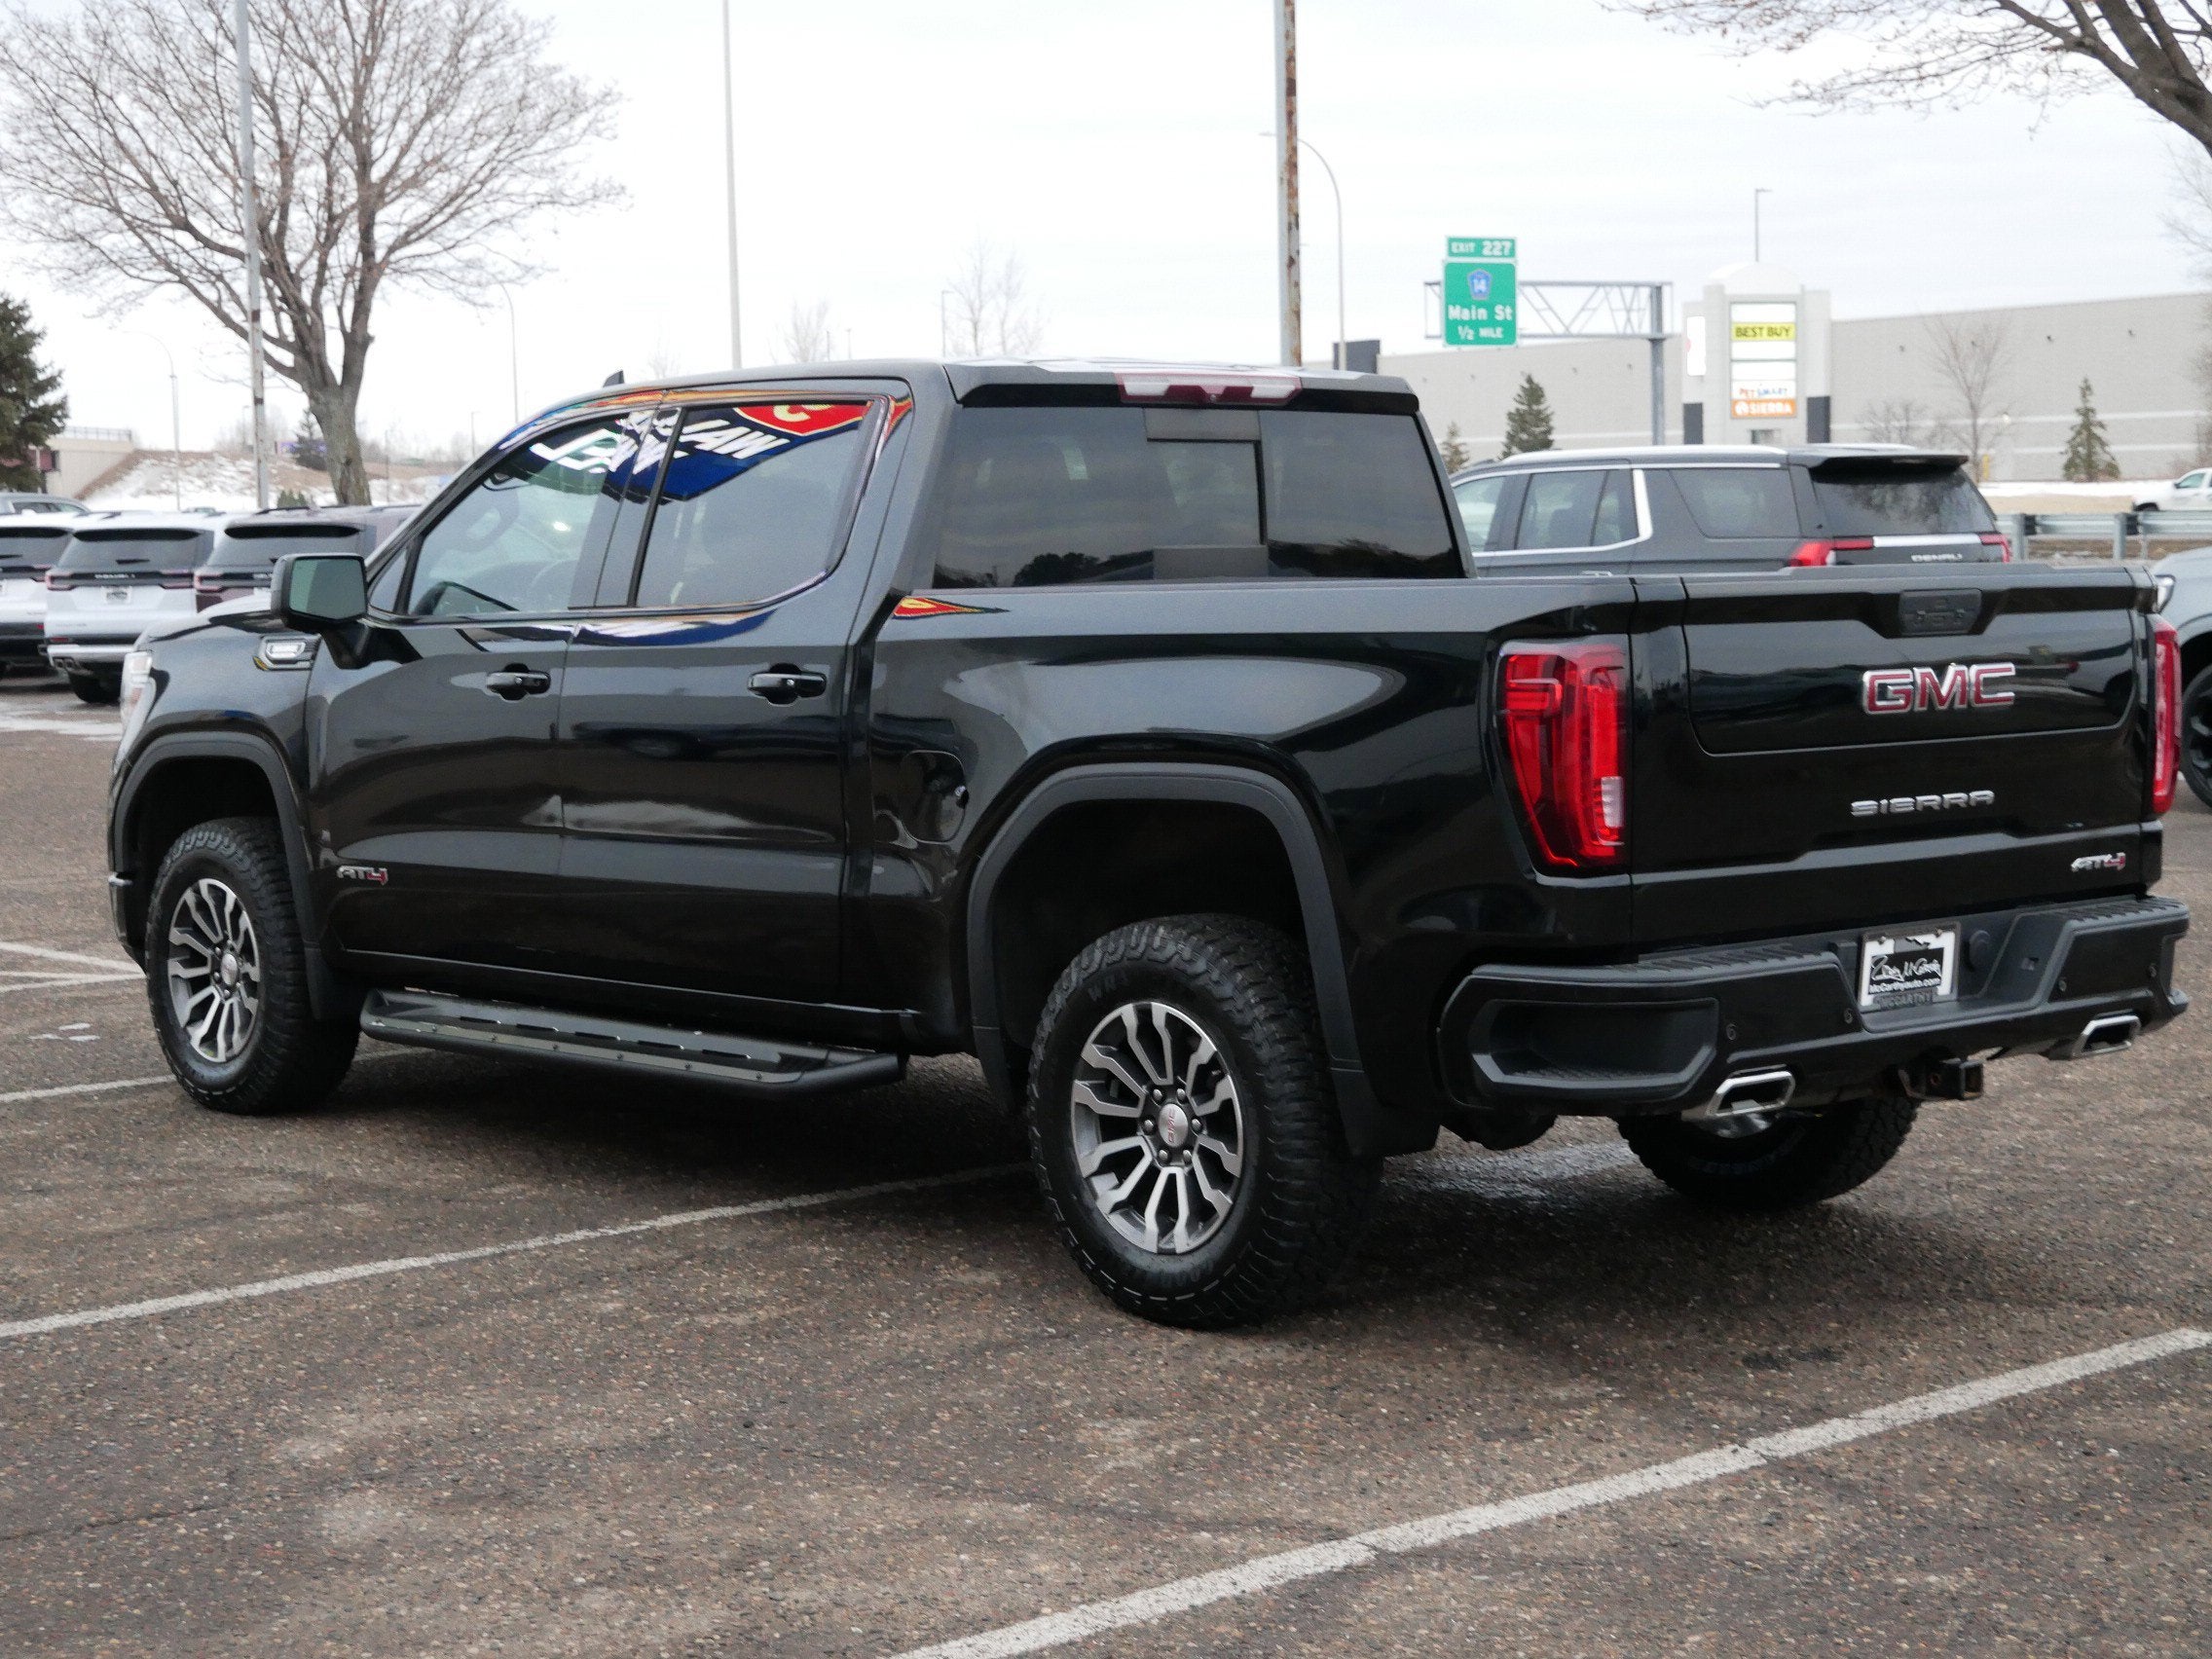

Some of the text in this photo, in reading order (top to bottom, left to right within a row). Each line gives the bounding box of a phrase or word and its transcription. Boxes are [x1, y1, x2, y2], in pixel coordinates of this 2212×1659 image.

[1482, 240, 1512, 256] 227
[1447, 304, 1513, 321] Main St
[1735, 325, 1792, 338] BEST BUY
[1862, 662, 2016, 715] GMC
[1850, 790, 1996, 818] SIERRA
[2071, 852, 2126, 872] AT4
[336, 865, 389, 886] AT4
